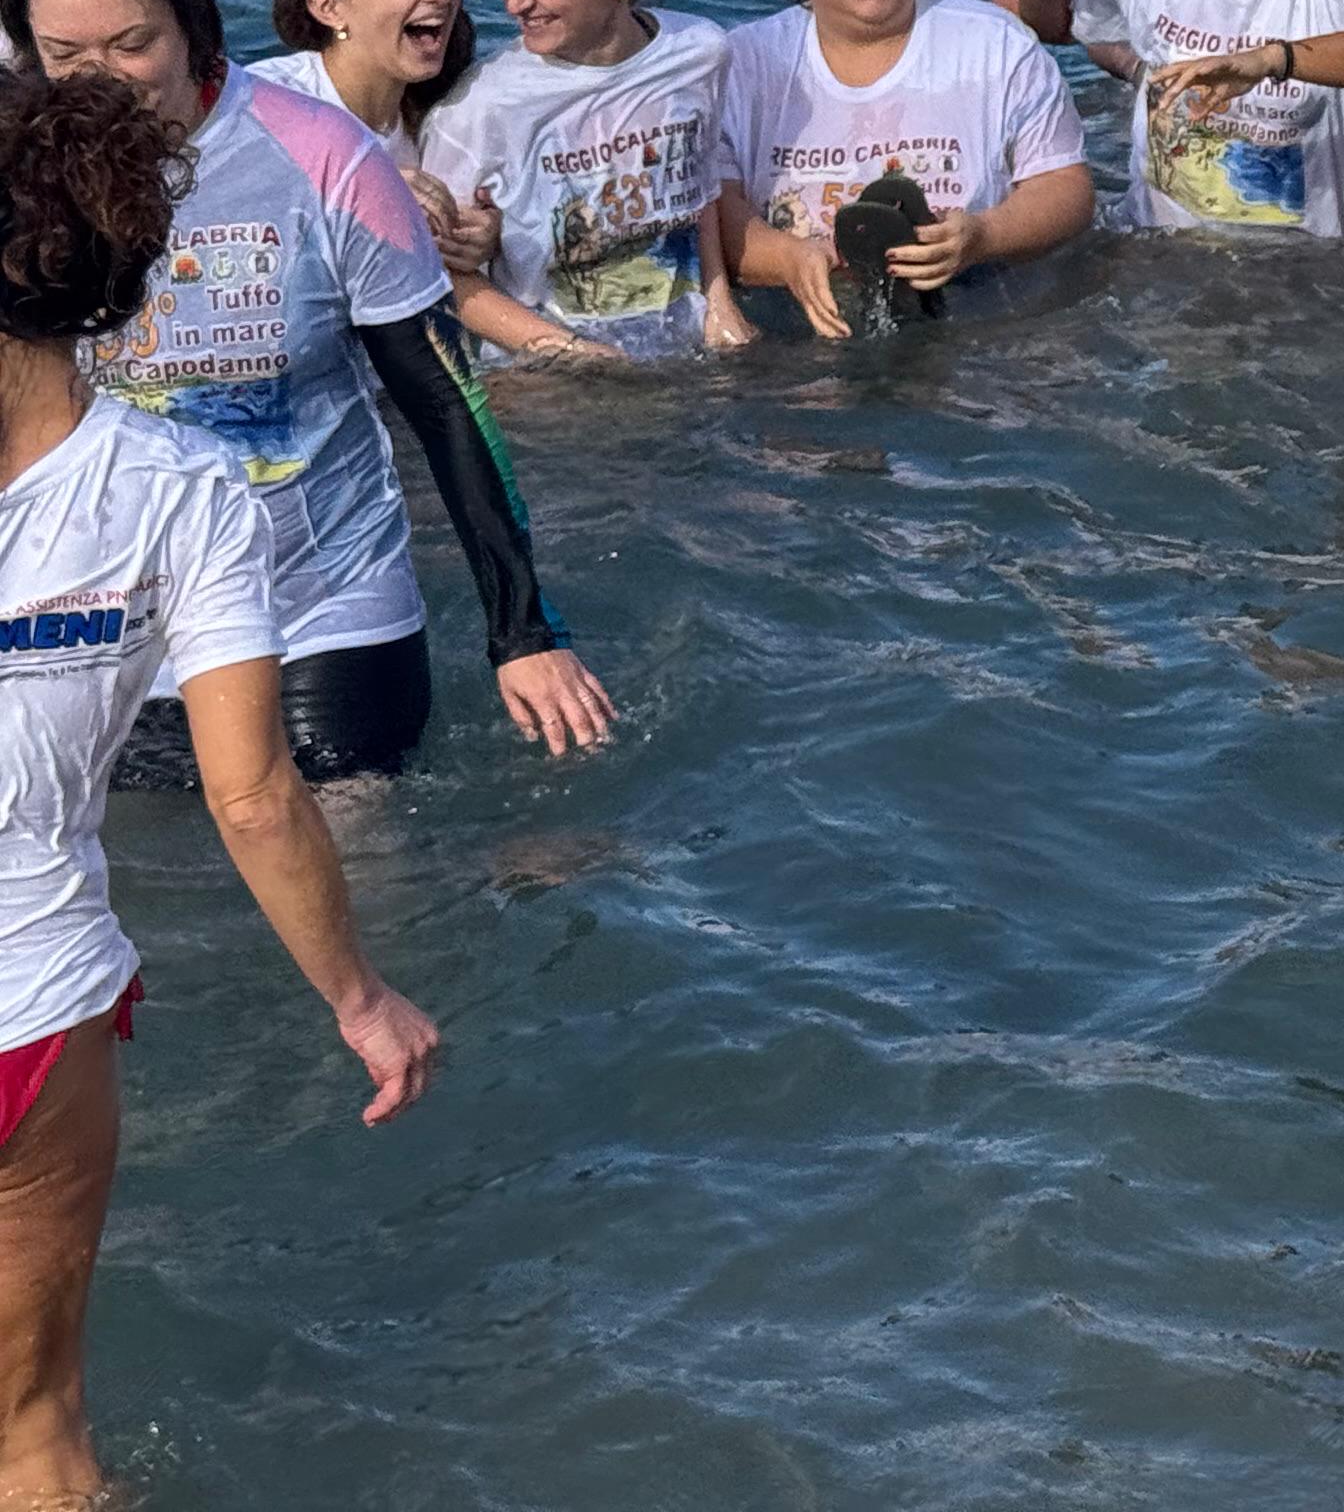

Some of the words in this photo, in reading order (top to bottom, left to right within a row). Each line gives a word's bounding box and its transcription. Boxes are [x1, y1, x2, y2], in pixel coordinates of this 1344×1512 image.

[1154, 13, 1222, 53] REGGIO
[1203, 115, 1300, 142] Capodanno
[541, 143, 613, 175] REGGIO
[855, 136, 963, 164] CALABRIA
[915, 177, 963, 196] uffo
[171, 224, 282, 251] LABRIA
[206, 283, 283, 312] Tuffo
[174, 321, 201, 347] in
[211, 321, 287, 344] mare
[125, 352, 290, 384] Capodanno
[15, 591, 104, 616] ASSISTENZA
